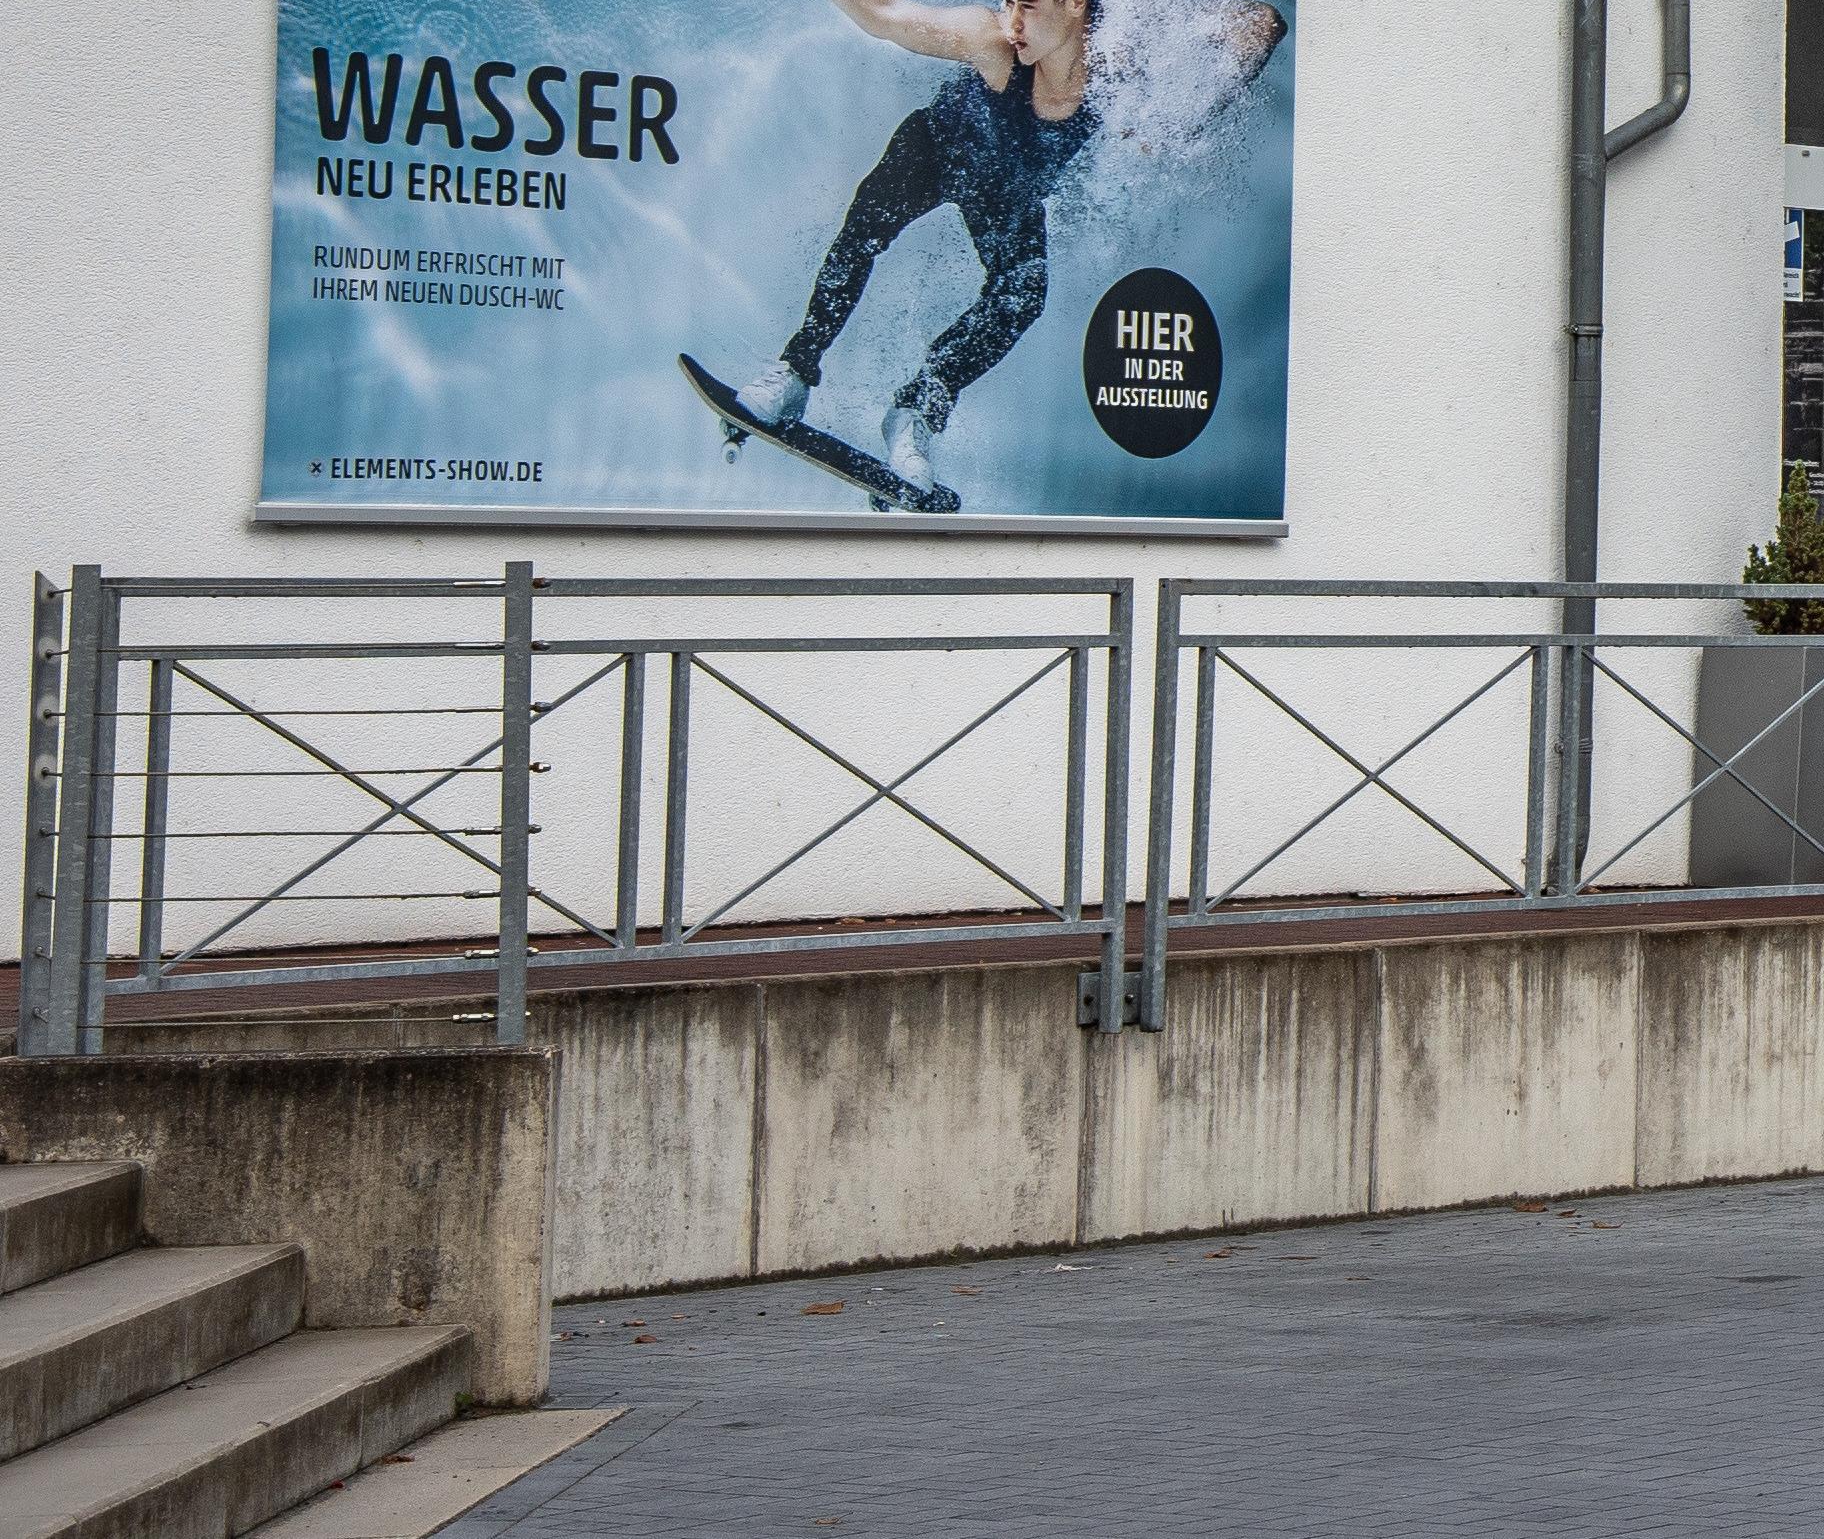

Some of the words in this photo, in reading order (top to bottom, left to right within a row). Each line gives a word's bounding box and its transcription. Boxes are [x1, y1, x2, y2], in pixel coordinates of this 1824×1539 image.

[312, 47, 679, 165] WASSER
[317, 157, 393, 202] NEU
[408, 163, 567, 210] ERLEBEN
[314, 245, 409, 271] RUNDUM
[417, 251, 526, 277] ERFRISCHT
[532, 257, 565, 279] MIT
[312, 277, 378, 301] IHREM
[385, 280, 453, 304] NEUEN
[459, 283, 565, 310] DUSCH-WC
[1115, 310, 1194, 352] HIER
[1124, 358, 1143, 379] IN
[1147, 359, 1184, 381] DER
[1096, 386, 1208, 410] AUSSTELLUNG
[330, 457, 543, 483] ELEMENTS-SHOW.DE
